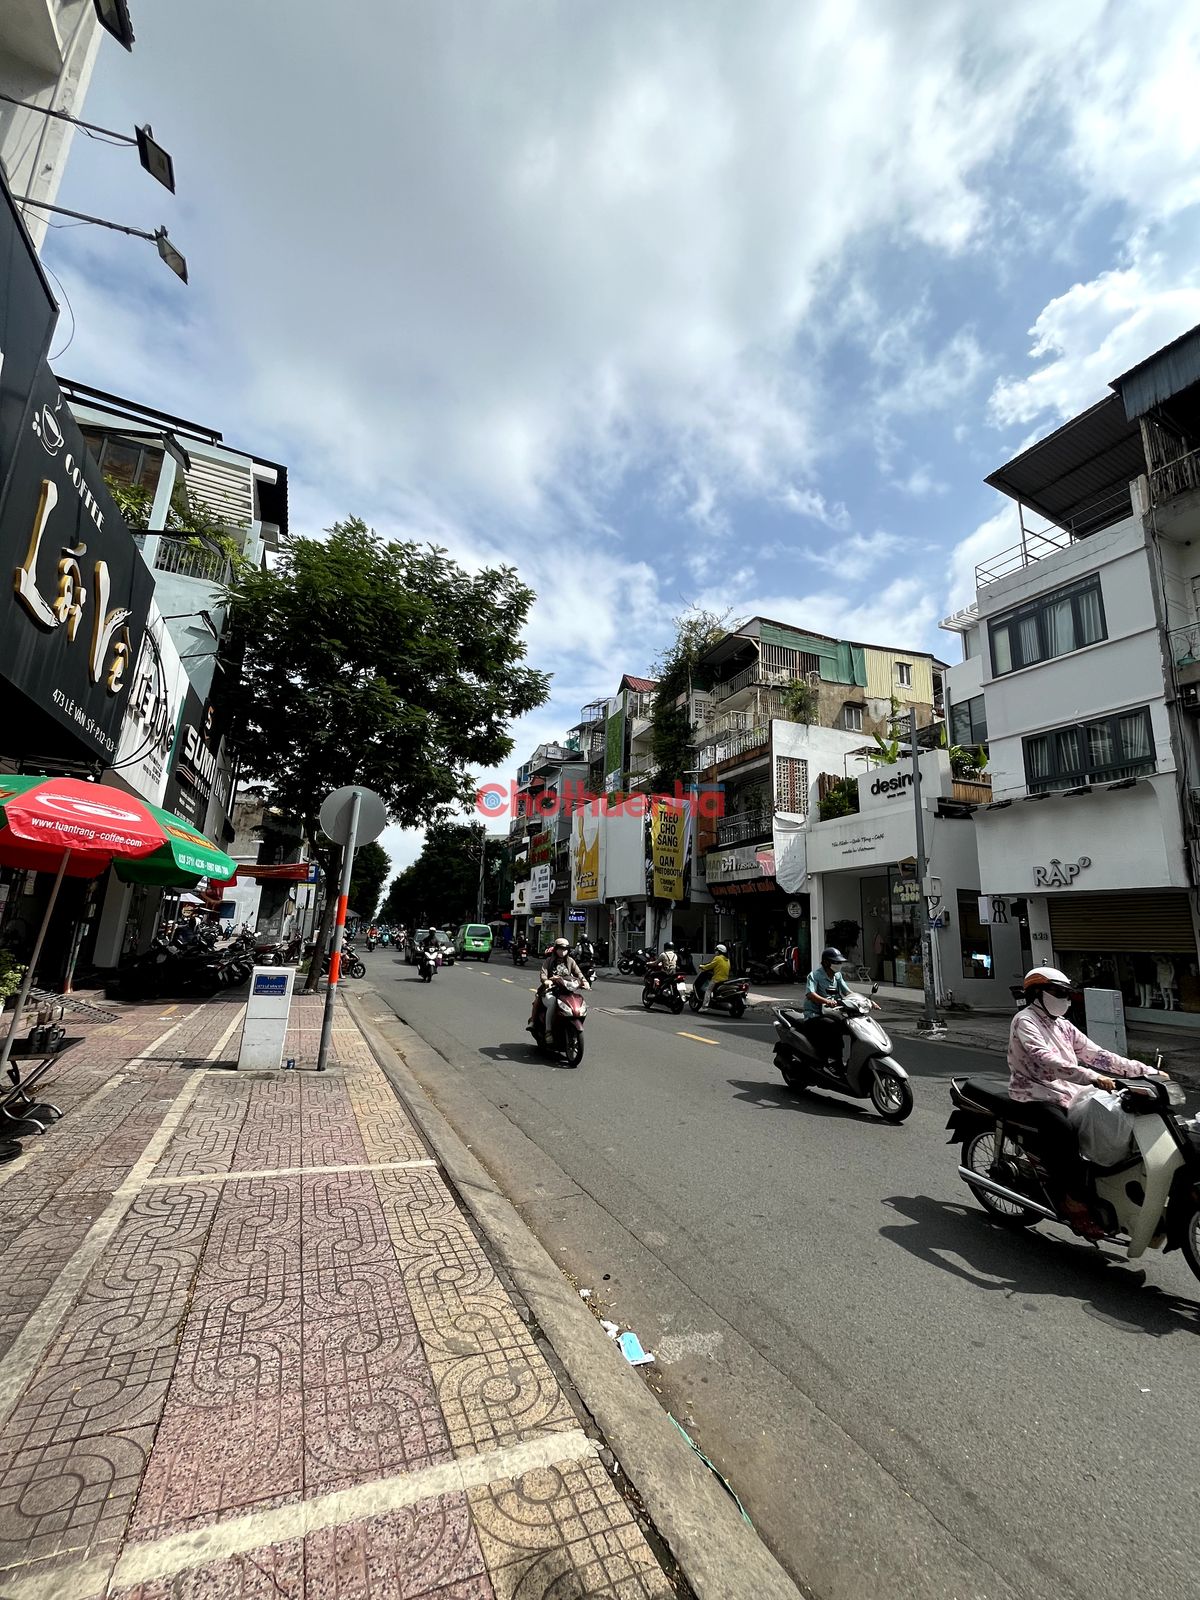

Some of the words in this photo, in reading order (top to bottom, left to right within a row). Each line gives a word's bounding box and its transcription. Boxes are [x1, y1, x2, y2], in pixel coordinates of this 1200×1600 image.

[65, 454, 105, 532] COFFEE
[52, 688, 65, 707] 473
[64, 698, 75, 716] LÊ
[183, 724, 217, 785] SUMI
[659, 811, 679, 824] TREO
[660, 823, 676, 835] CHO
[657, 834, 678, 848] SANG
